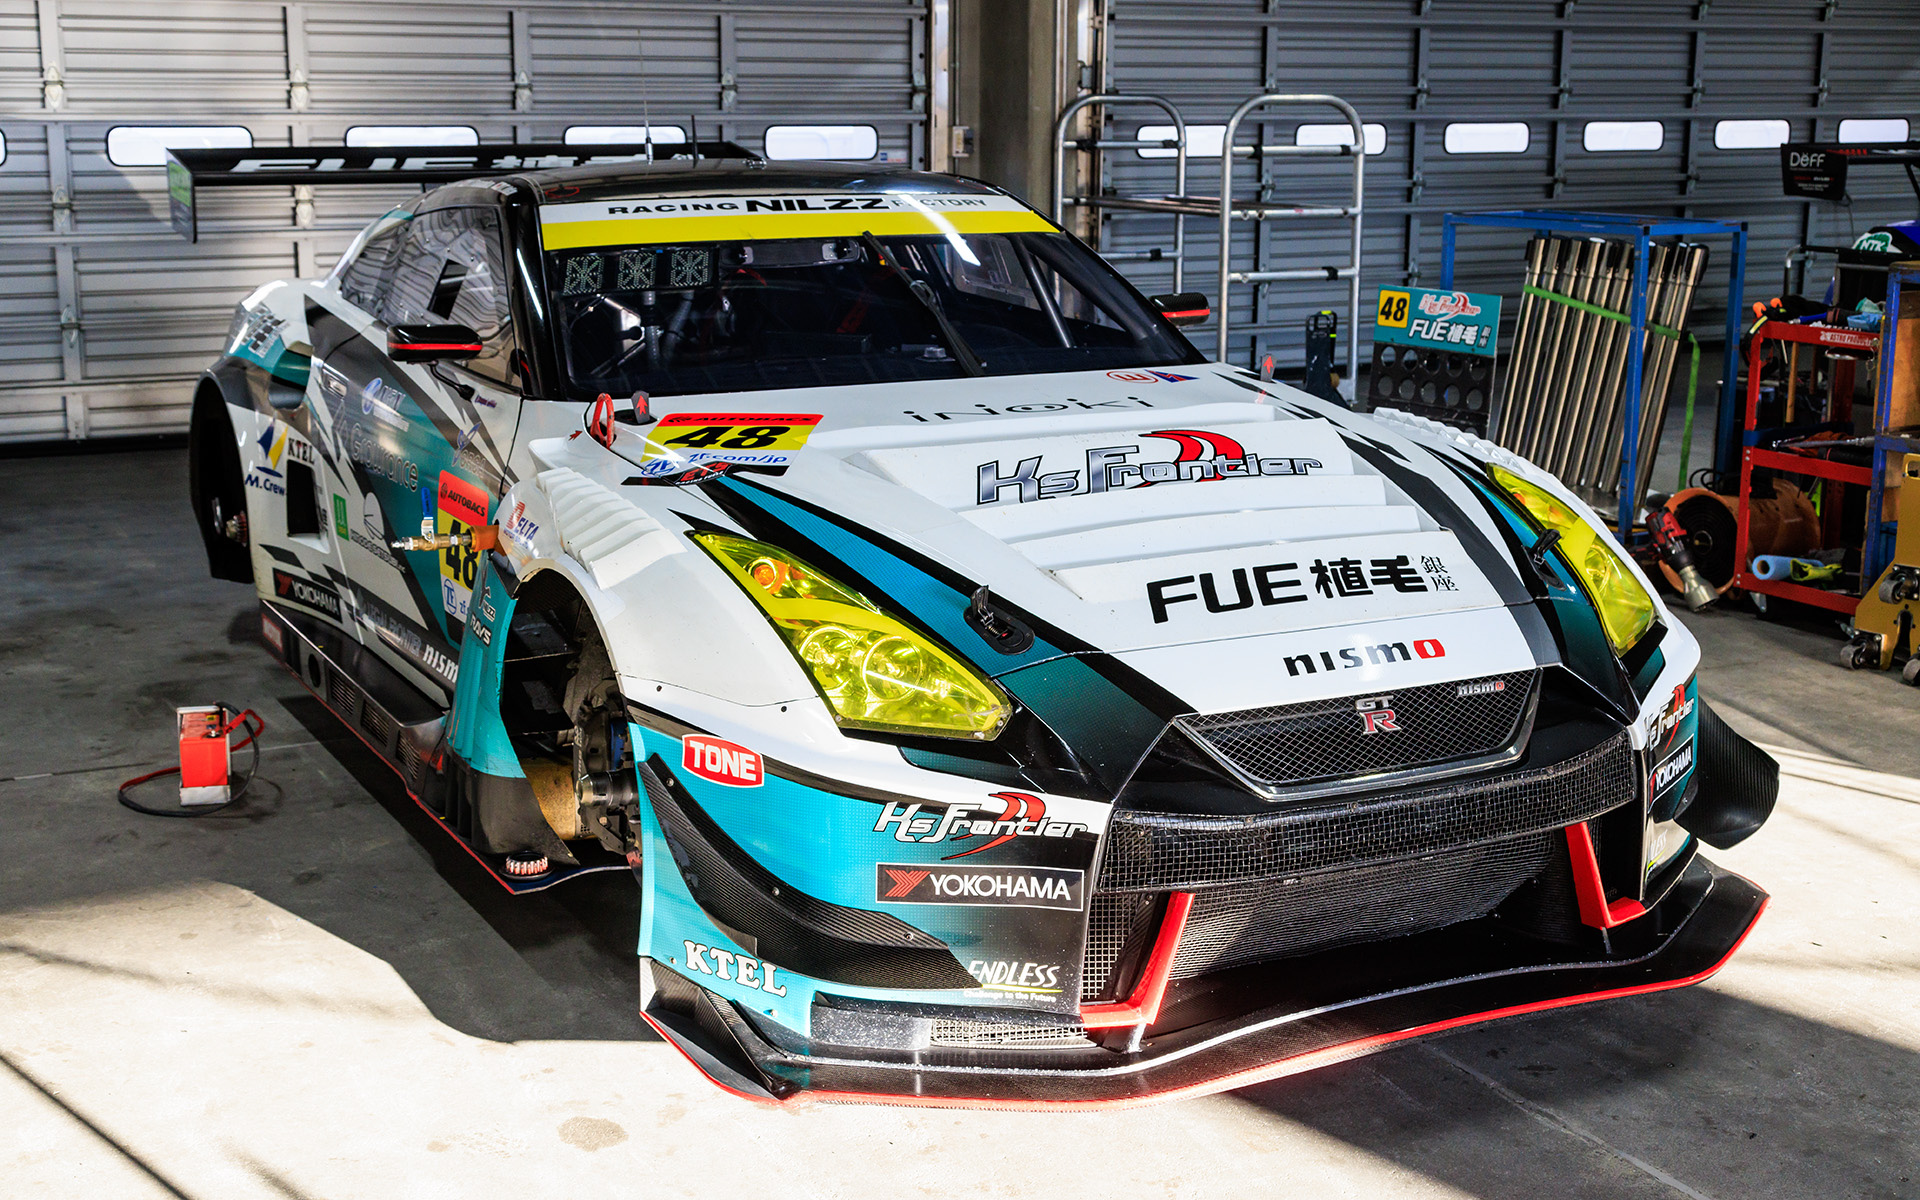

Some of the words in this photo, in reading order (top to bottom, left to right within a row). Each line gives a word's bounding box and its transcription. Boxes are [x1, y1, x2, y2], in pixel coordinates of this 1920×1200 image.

[608, 202, 740, 215] RACING
[746, 198, 891, 213] NILZZ
[1380, 297, 1408, 321] 48
[288, 437, 315, 465] KTEL
[664, 426, 791, 449] 48
[681, 461, 733, 482] ETS
[448, 489, 486, 518] AUTOBACS
[292, 580, 340, 615] YOKOHAMA
[470, 612, 492, 646] RAYS
[422, 644, 459, 684] nism
[1283, 639, 1446, 677] nismo
[1456, 680, 1505, 697] nismo
[1355, 695, 1394, 711] GT
[1360, 709, 1401, 736] R
[689, 740, 757, 782] TONE
[1655, 745, 1692, 791] YOKOHAMA
[929, 873, 1072, 901] YOKOHAMA
[683, 939, 788, 998] KTEL
[967, 960, 1060, 988] ENDLESS
[1005, 991, 1014, 999] to
[1015, 991, 1029, 1000] the
[1030, 993, 1057, 1003] Future
